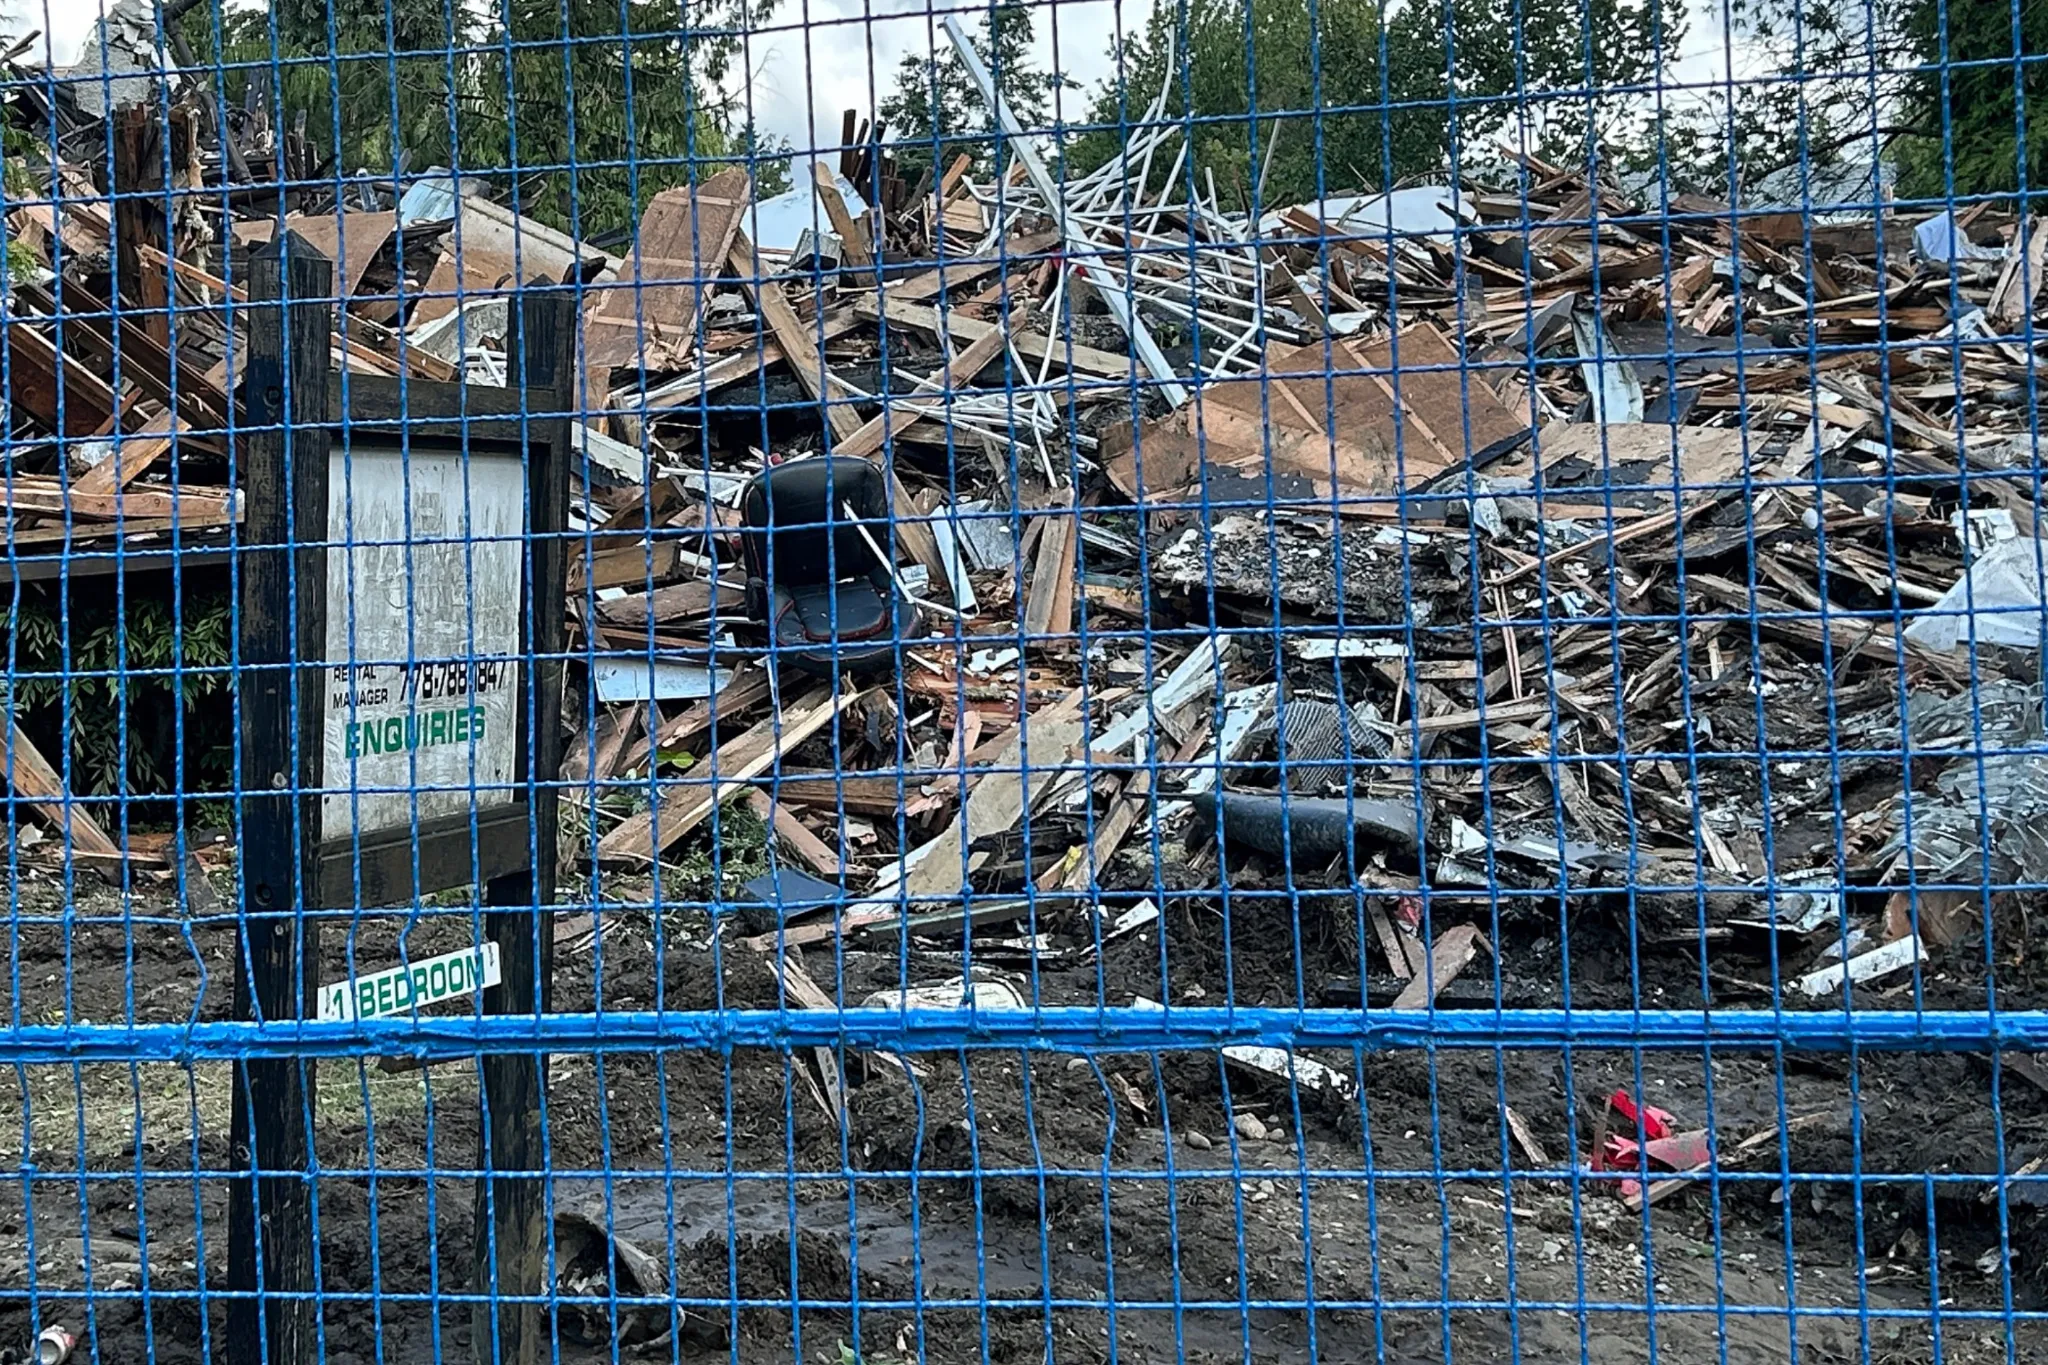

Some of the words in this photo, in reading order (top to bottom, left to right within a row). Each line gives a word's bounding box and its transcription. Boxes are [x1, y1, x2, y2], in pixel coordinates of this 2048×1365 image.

[334, 665, 377, 683] RETAL
[345, 706, 485, 759] ENQUIRIES
[332, 988, 345, 1019] 1
[358, 952, 486, 1018] BEDROOM
